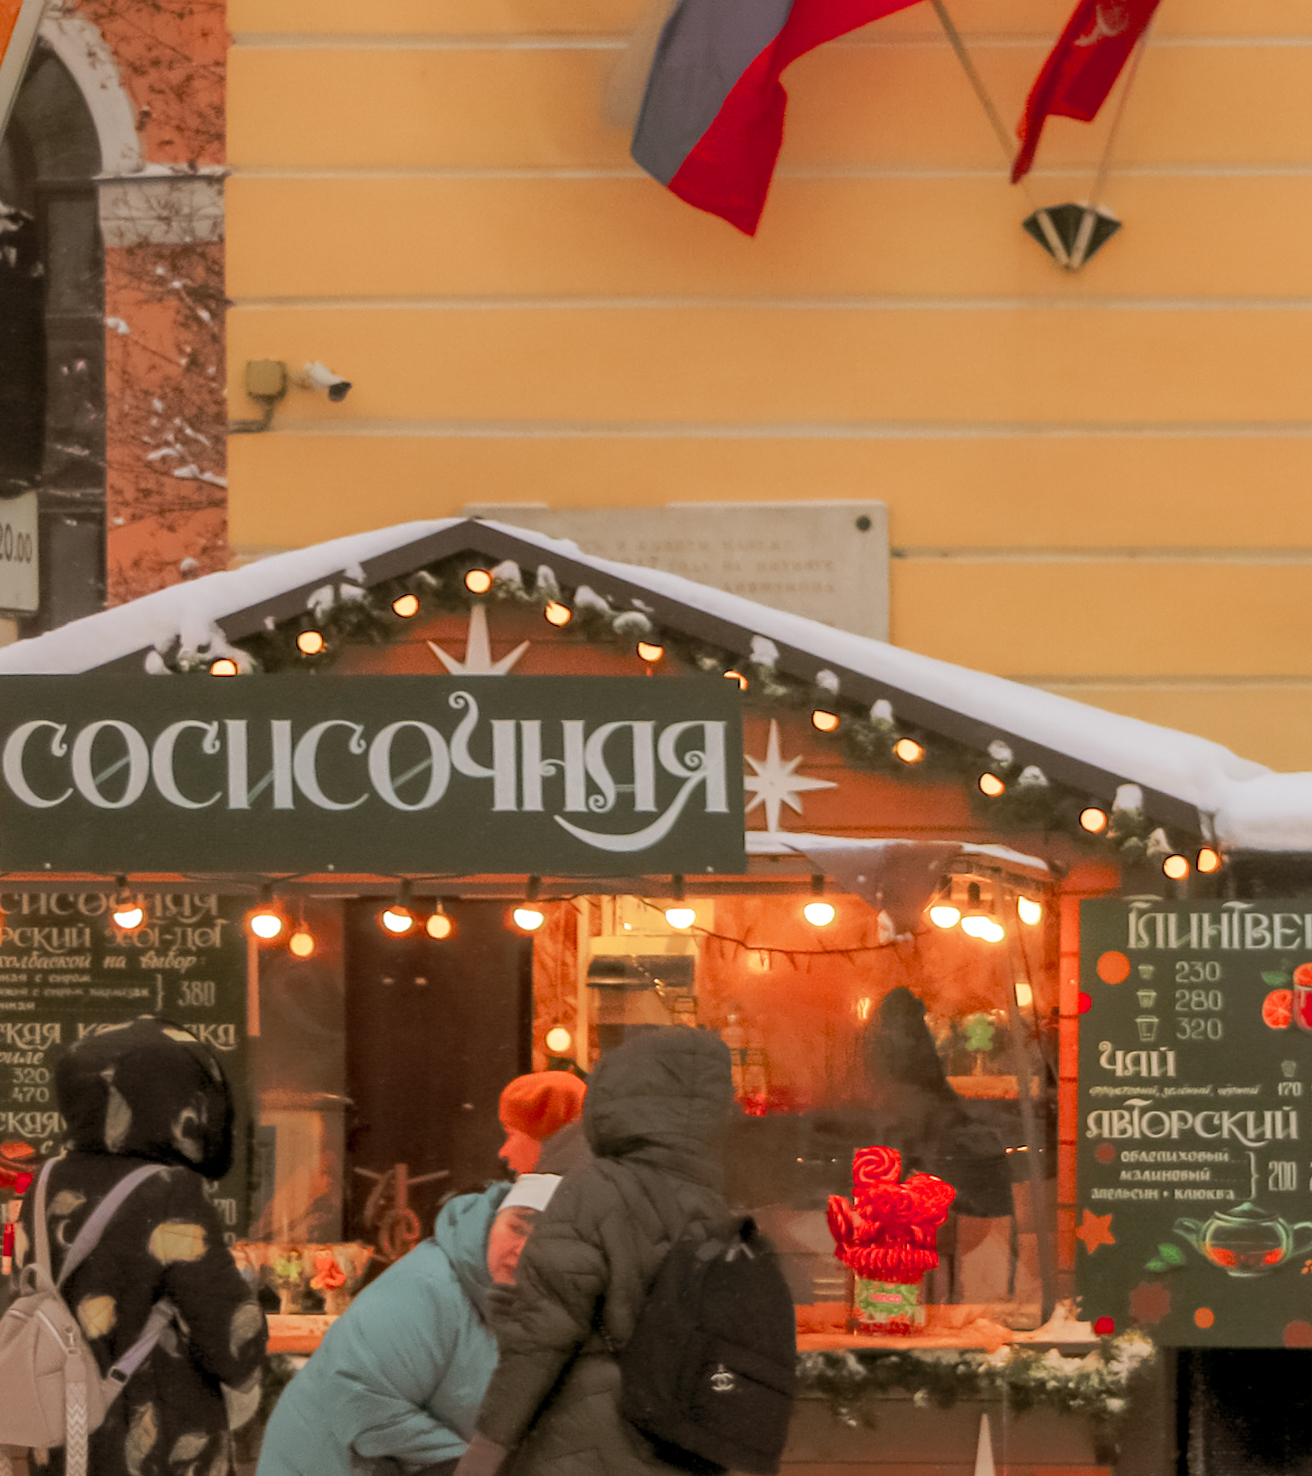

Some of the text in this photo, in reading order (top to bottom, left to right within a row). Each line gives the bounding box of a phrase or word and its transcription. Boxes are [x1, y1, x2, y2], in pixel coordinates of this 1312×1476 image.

[0, 522, 33, 564] 0.00
[2, 690, 731, 853] СОСИСОЧНАЯ
[0, 923, 91, 953] РСКИЙ
[1175, 961, 1221, 984] 230
[176, 980, 216, 1007] 380
[1174, 990, 1223, 1012] 280
[1175, 1018, 1223, 1040] 320
[1098, 1041, 1177, 1078] ЧАЙ
[12, 1067, 50, 1084] 320
[12, 1086, 50, 1102] 470
[1278, 1082, 1302, 1097] 170
[1086, 1098, 1299, 1147] АВТОРСКИЙ
[1268, 1160, 1297, 1191] 200
